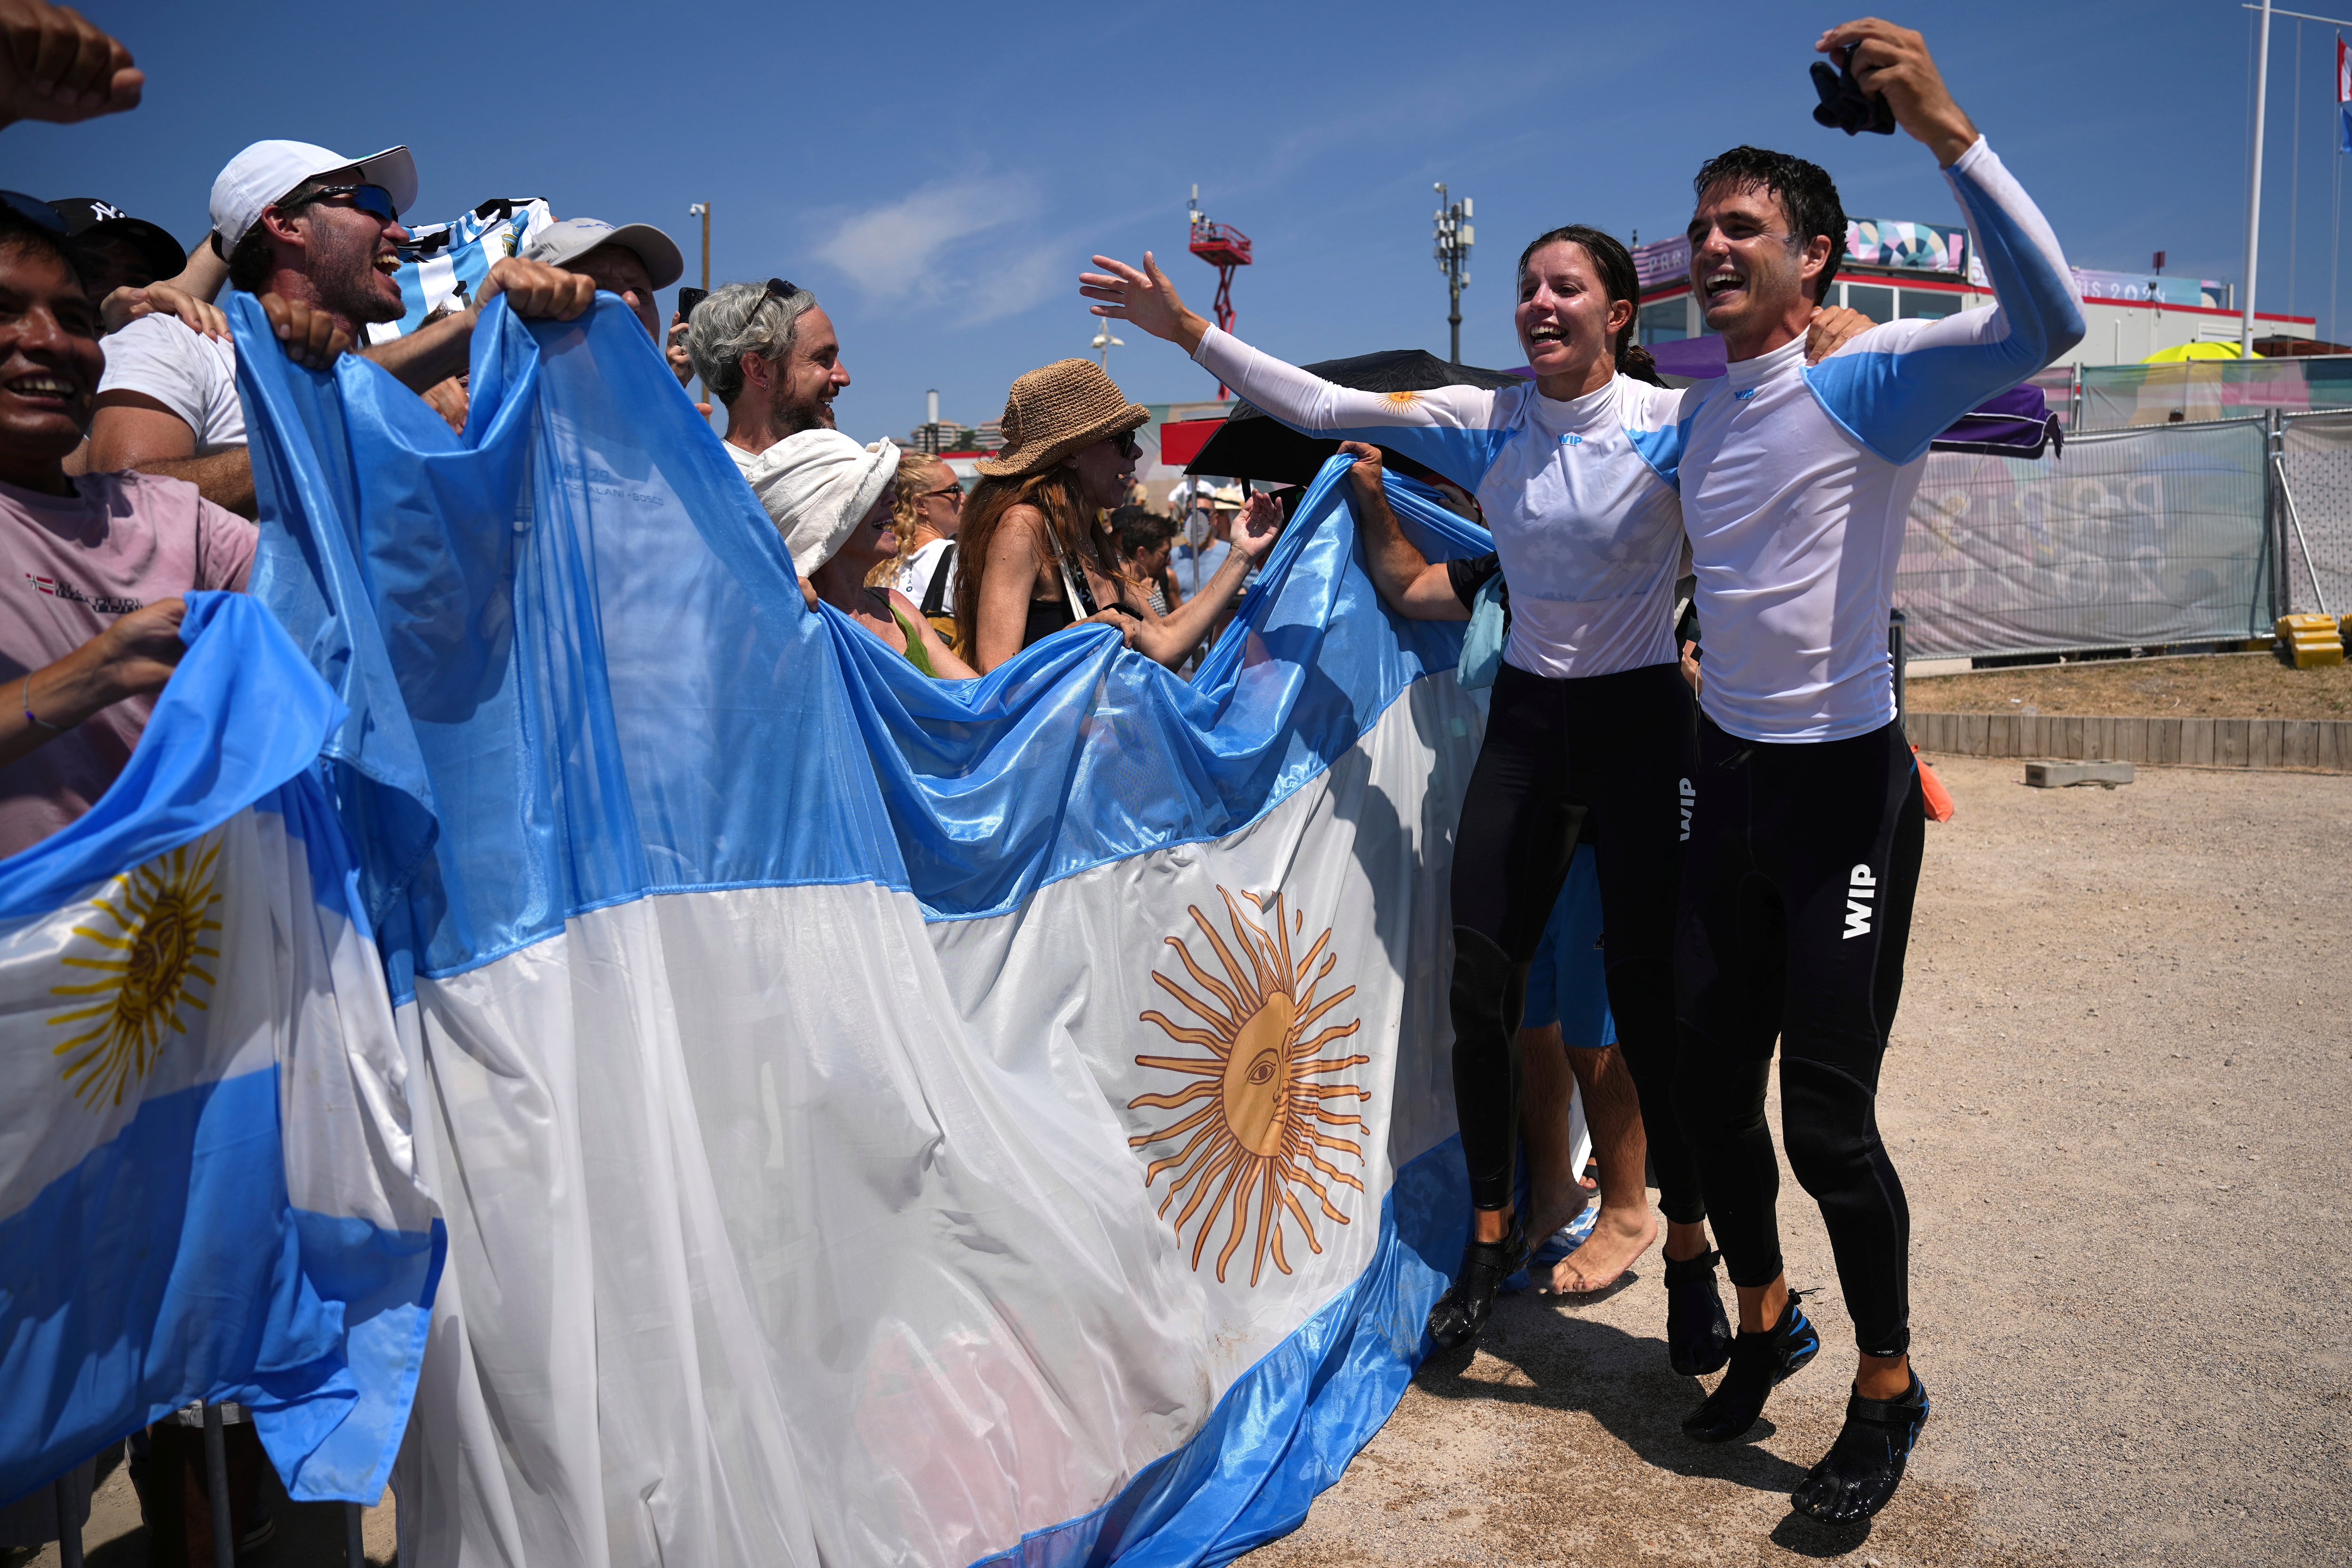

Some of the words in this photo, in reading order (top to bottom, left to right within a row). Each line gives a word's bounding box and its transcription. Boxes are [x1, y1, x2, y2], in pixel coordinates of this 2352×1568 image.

[1648, 246, 1688, 273] PARI
[2075, 279, 2101, 298] RIS
[2110, 283, 2166, 303] 2024
[1557, 435, 1582, 445] WIP
[589, 468, 610, 483] 29
[633, 493, 664, 506] BOSCO
[1679, 777, 1696, 841] WIP
[1842, 863, 1876, 939] WIP
